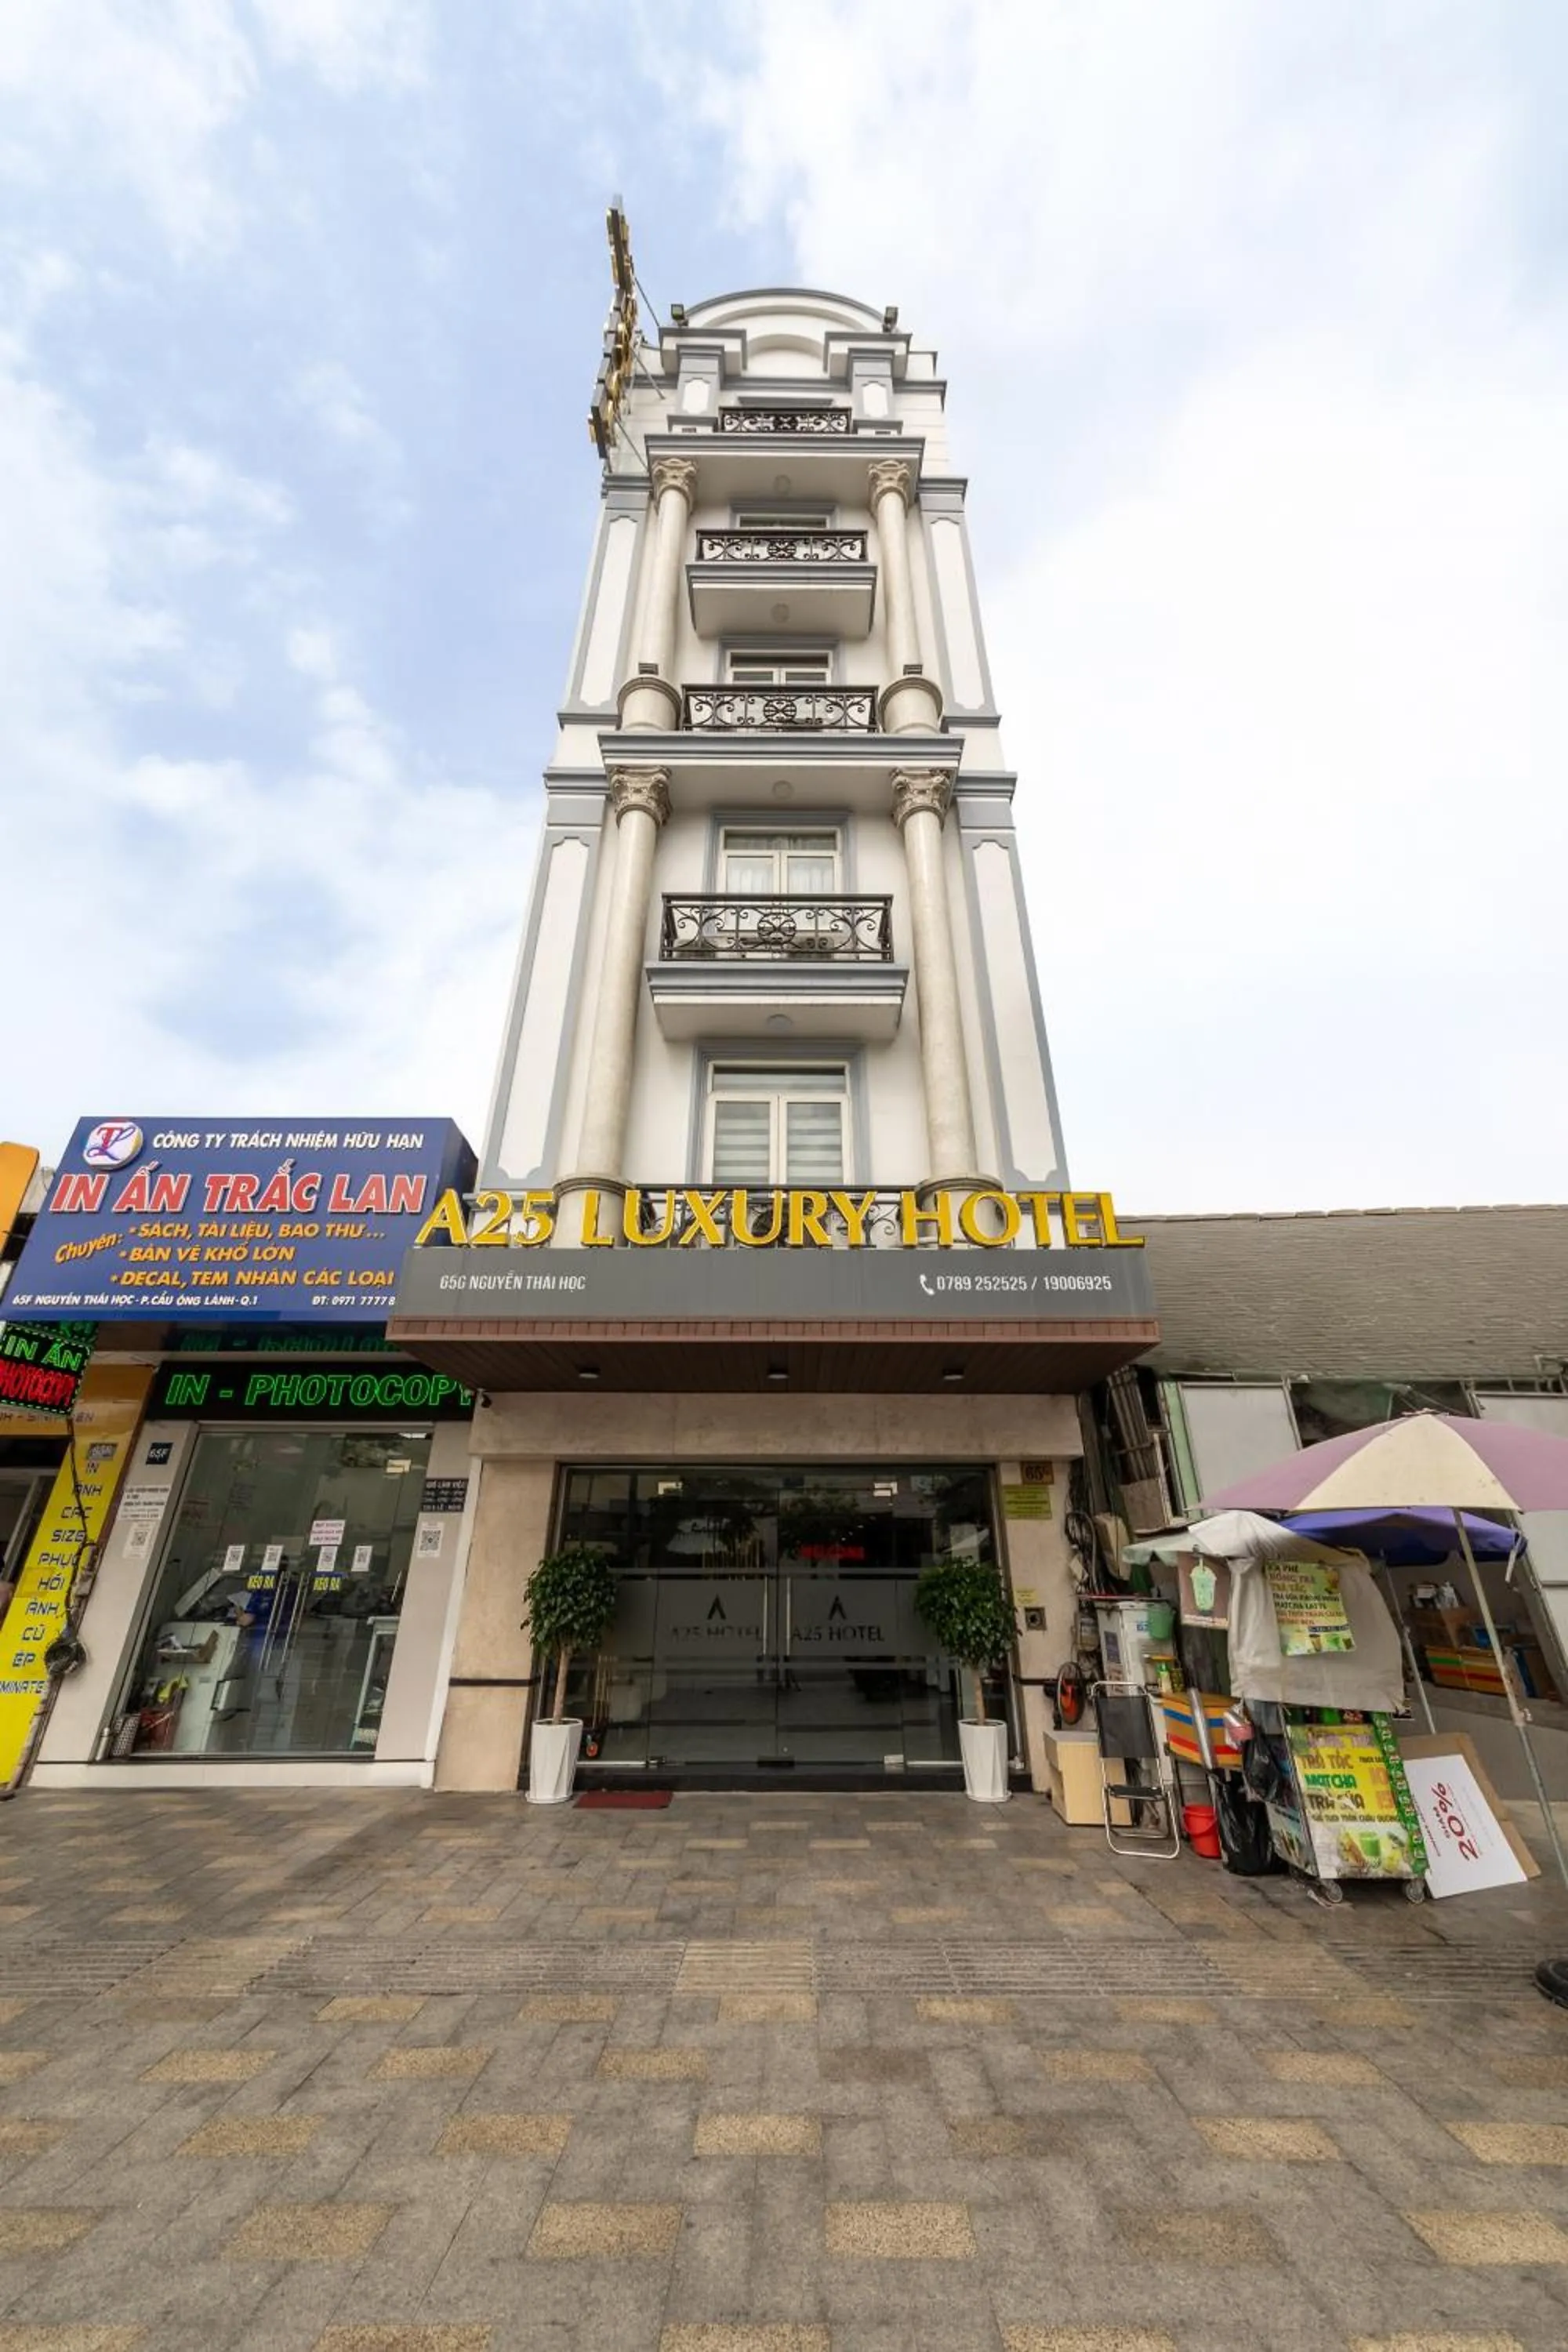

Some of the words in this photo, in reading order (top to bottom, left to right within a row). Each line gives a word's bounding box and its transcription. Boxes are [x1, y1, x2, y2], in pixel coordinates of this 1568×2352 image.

[153, 1130, 200, 1149] CÔNG
[205, 1134, 227, 1149] TY
[230, 1129, 281, 1149] TRÁCH
[285, 1130, 338, 1151] NHIỆM
[343, 1131, 381, 1149] HỮU
[387, 1133, 424, 1150] HẠN
[49, 1174, 110, 1213] IN
[112, 1160, 192, 1213] ẤN
[203, 1157, 322, 1214] TRẮC
[327, 1174, 427, 1214] LAN
[413, 1187, 555, 1248] A25
[579, 1189, 877, 1247] LUXURY
[900, 1189, 1147, 1249] HOTEL
[137, 1219, 193, 1240] SÁCH,
[198, 1220, 227, 1238] TÀI
[278, 1223, 319, 1238] BAO
[252, 1243, 296, 1261] LỚN
[119, 1271, 188, 1289] DECAL,
[191, 1271, 228, 1287] TEM
[303, 1267, 343, 1286] CÁC
[347, 1270, 395, 1288] LOẠI
[469, 1271, 524, 1290] NGUYỄN
[526, 1273, 557, 1290] THÁI
[559, 1275, 586, 1292] HỌC
[936, 1276, 972, 1291] 0789
[975, 1276, 1028, 1291] 252525
[1044, 1276, 1112, 1291] 19006925
[331, 1296, 355, 1305] 0971
[4, 1335, 39, 1360] IN
[165, 1374, 211, 1405] IN
[245, 1374, 471, 1406] PHOTOCOPY
[51, 1530, 87, 1542] SIZE
[792, 1626, 822, 1642] A25
[828, 1624, 885, 1642] HOTEL
[1304, 1773, 1358, 1789] MATCHA
[1430, 1781, 1479, 1861] 20%
